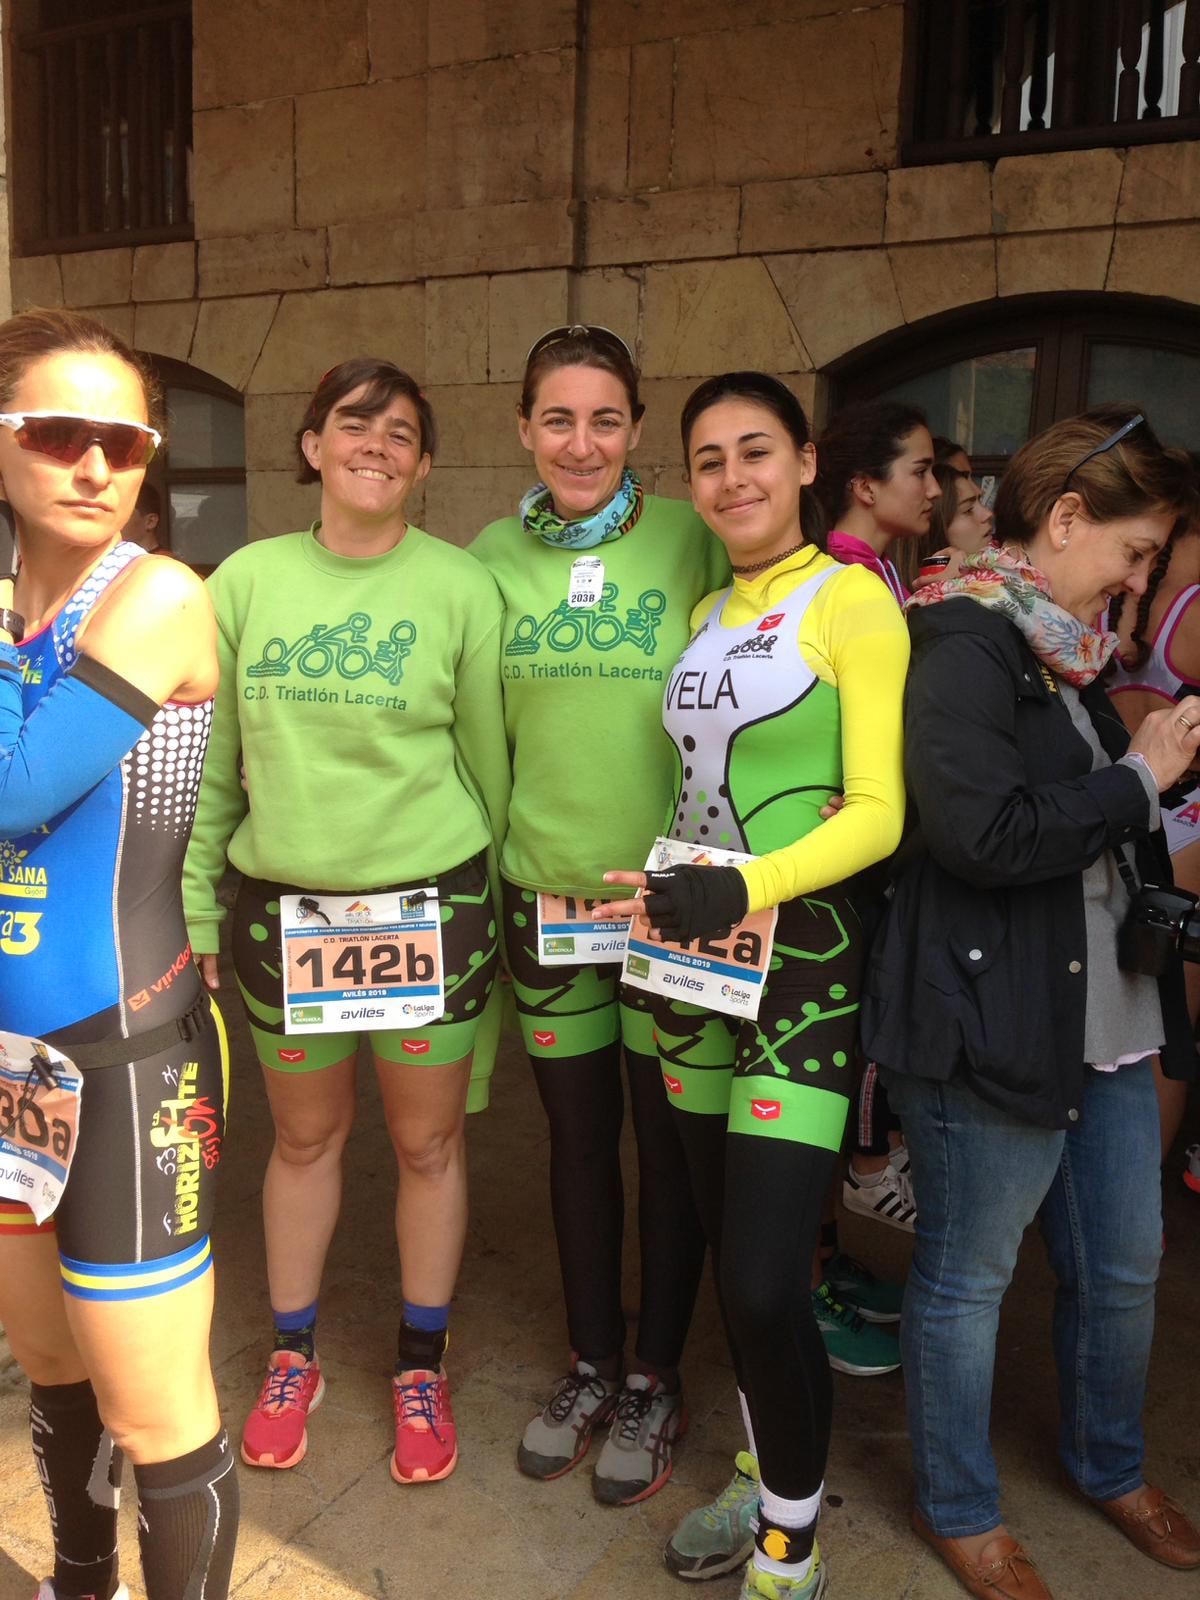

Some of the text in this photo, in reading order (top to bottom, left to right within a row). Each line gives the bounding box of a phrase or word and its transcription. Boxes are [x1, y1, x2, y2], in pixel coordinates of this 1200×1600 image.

[503, 662, 664, 681] C.D. Triatlón Lacerta
[243, 685, 408, 711] C.D. Triatlón Lacerta
[666, 668, 740, 711] VELA
[8, 866, 48, 885] SANA
[339, 935, 370, 943] TRIATLÓN
[371, 934, 400, 942] LACERTA
[591, 940, 627, 952] avilé
[295, 943, 435, 988] 142b
[667, 952, 711, 969] AVILÉS 2019
[342, 990, 367, 998] AVILÉS
[340, 1007, 386, 1020] avilés
